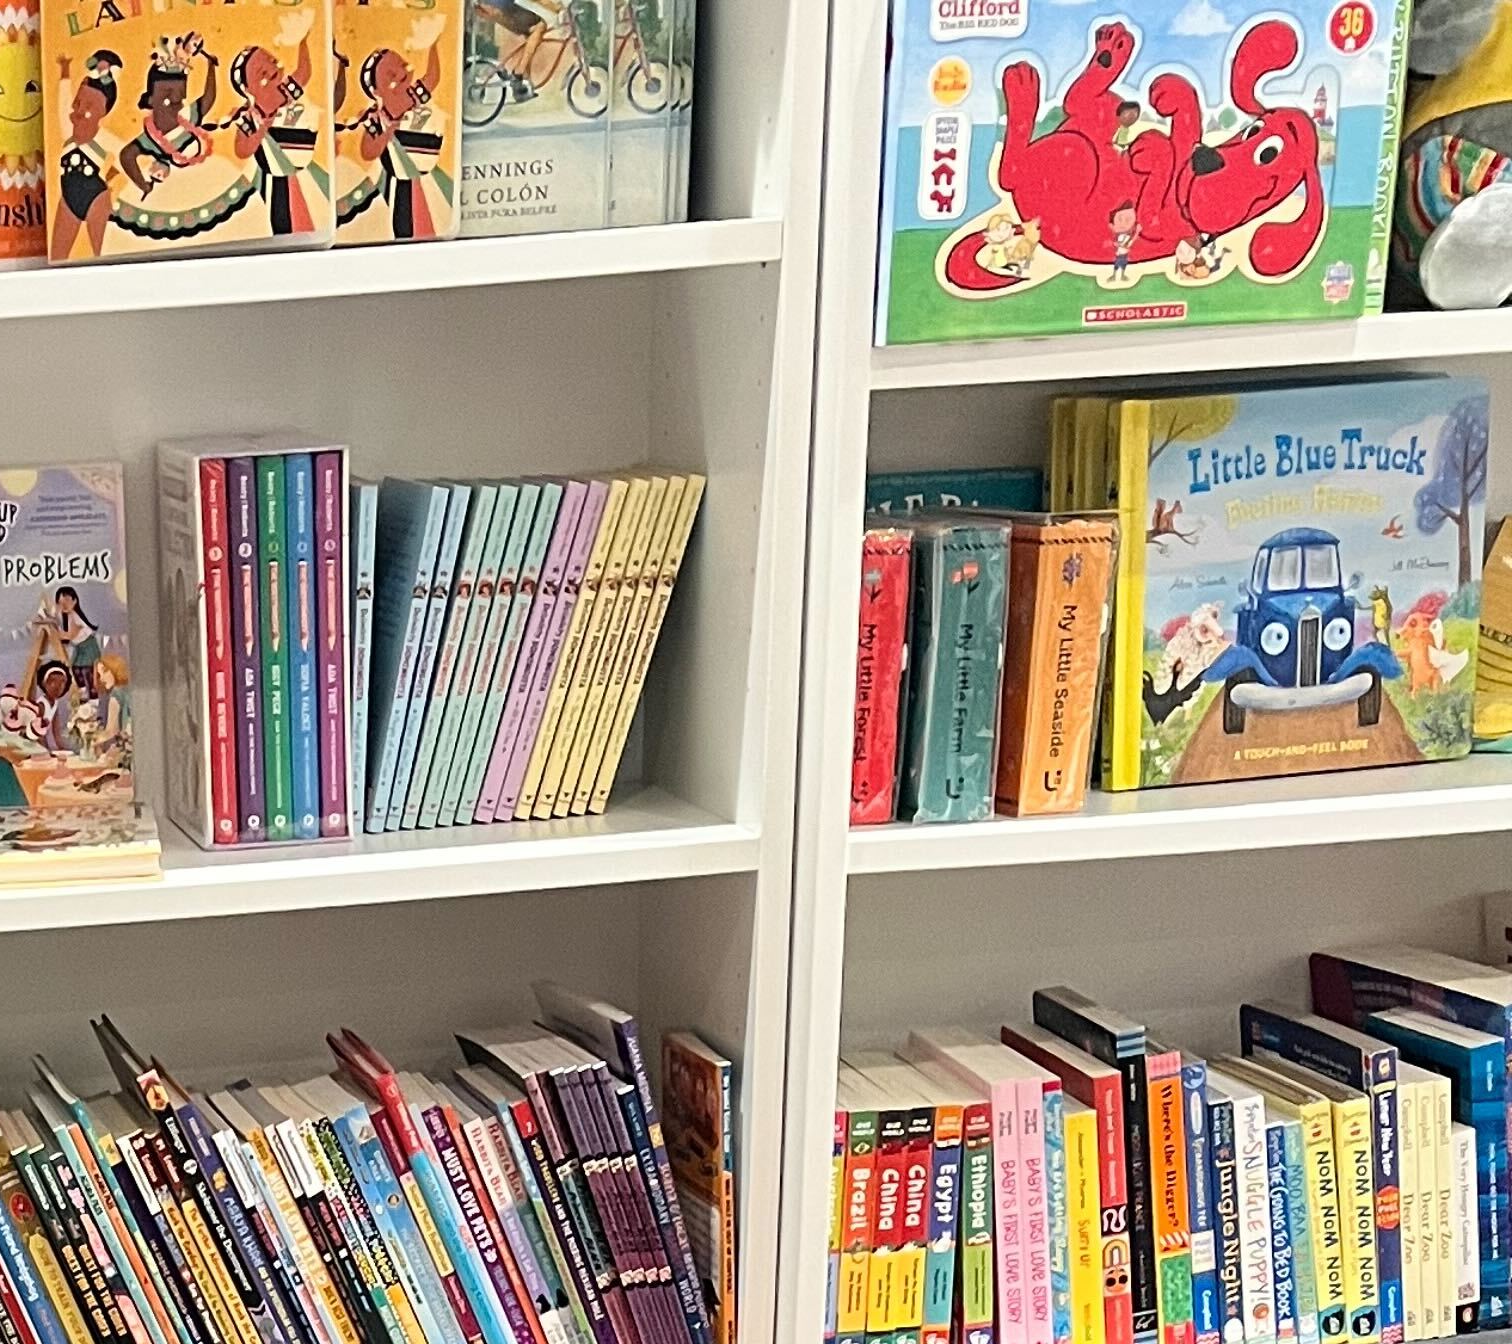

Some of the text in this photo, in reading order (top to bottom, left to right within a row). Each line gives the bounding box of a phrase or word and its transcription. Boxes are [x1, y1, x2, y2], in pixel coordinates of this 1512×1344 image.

[1339, 10, 1365, 37] 36
[1098, 306, 1184, 323] SCHOLASTIC
[1187, 427, 1427, 494] Little Blue Truck
[4, 550, 112, 586] PROBLEMS
[859, 623, 878, 656] My
[1049, 605, 1078, 758] My Little Seaside
[853, 707, 871, 763] Forest
[952, 708, 969, 754] Farm
[440, 1145, 494, 1250] MUST LOVE PETS
[849, 1167, 872, 1232] Brazil
[877, 1168, 900, 1232] China
[904, 1164, 927, 1229] China
[933, 1163, 958, 1224] Egypt
[970, 1153, 988, 1230] Ethiopia
[1242, 1143, 1270, 1303] SNUGGLE PUPPY!
[1216, 1159, 1241, 1308] Jungle Night
[1315, 1150, 1344, 1301] NOM NOM NOM
[1353, 1149, 1375, 1301] NOM NOM NOM
[1274, 1245, 1292, 1278] BED
[1276, 1278, 1292, 1319] BOOK
